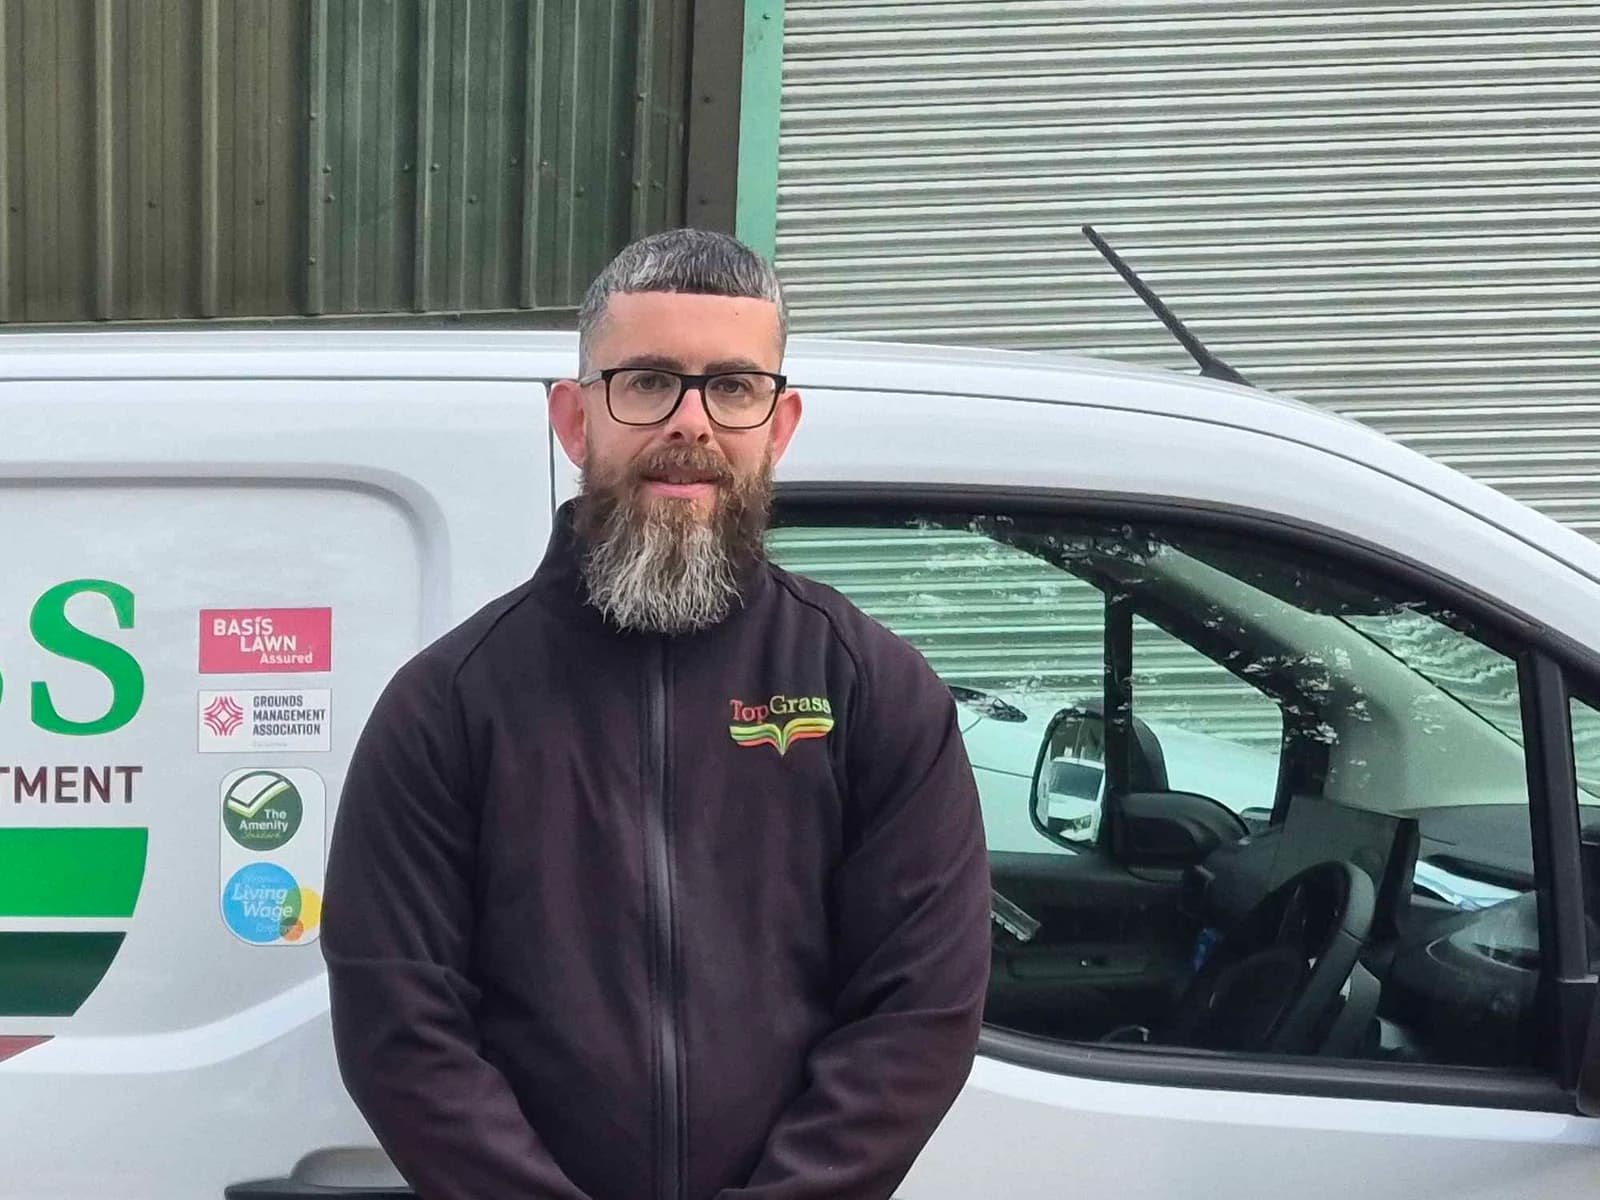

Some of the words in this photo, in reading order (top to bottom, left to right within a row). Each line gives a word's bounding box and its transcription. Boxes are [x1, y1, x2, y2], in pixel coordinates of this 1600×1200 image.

[240, 635, 297, 652] LAWN
[259, 652, 313, 664] Assured
[252, 695, 303, 708] GROUNDS
[252, 709, 326, 722] MANAGEMENT
[252, 723, 321, 736] ASSOCIATION
[263, 808, 287, 820] The
[239, 819, 289, 832] Amenity
[232, 882, 288, 904] Living
[242, 901, 293, 921] Wage
